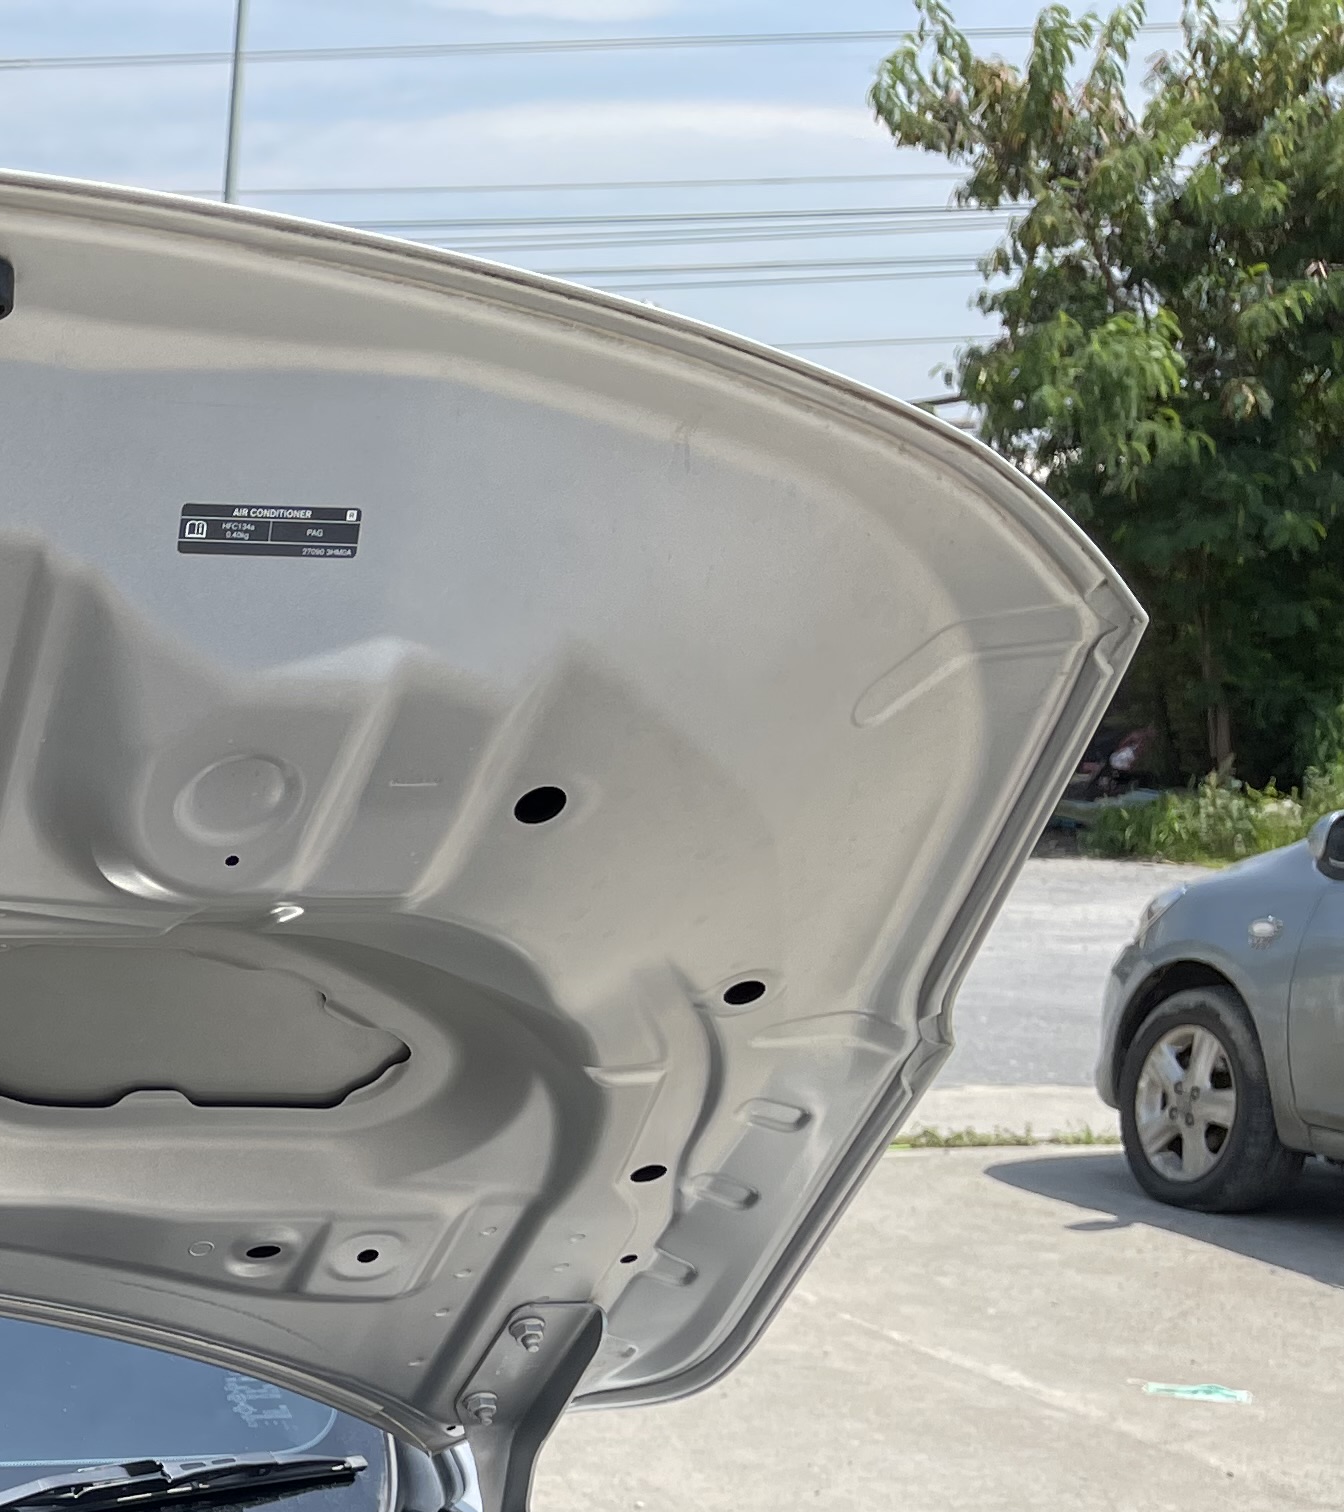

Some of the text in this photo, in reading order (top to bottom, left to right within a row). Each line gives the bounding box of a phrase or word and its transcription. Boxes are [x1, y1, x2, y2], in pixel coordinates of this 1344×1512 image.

[232, 508, 312, 518] AIR CONDITIONER
[222, 522, 255, 531] HFC134a
[306, 529, 324, 537] PAG
